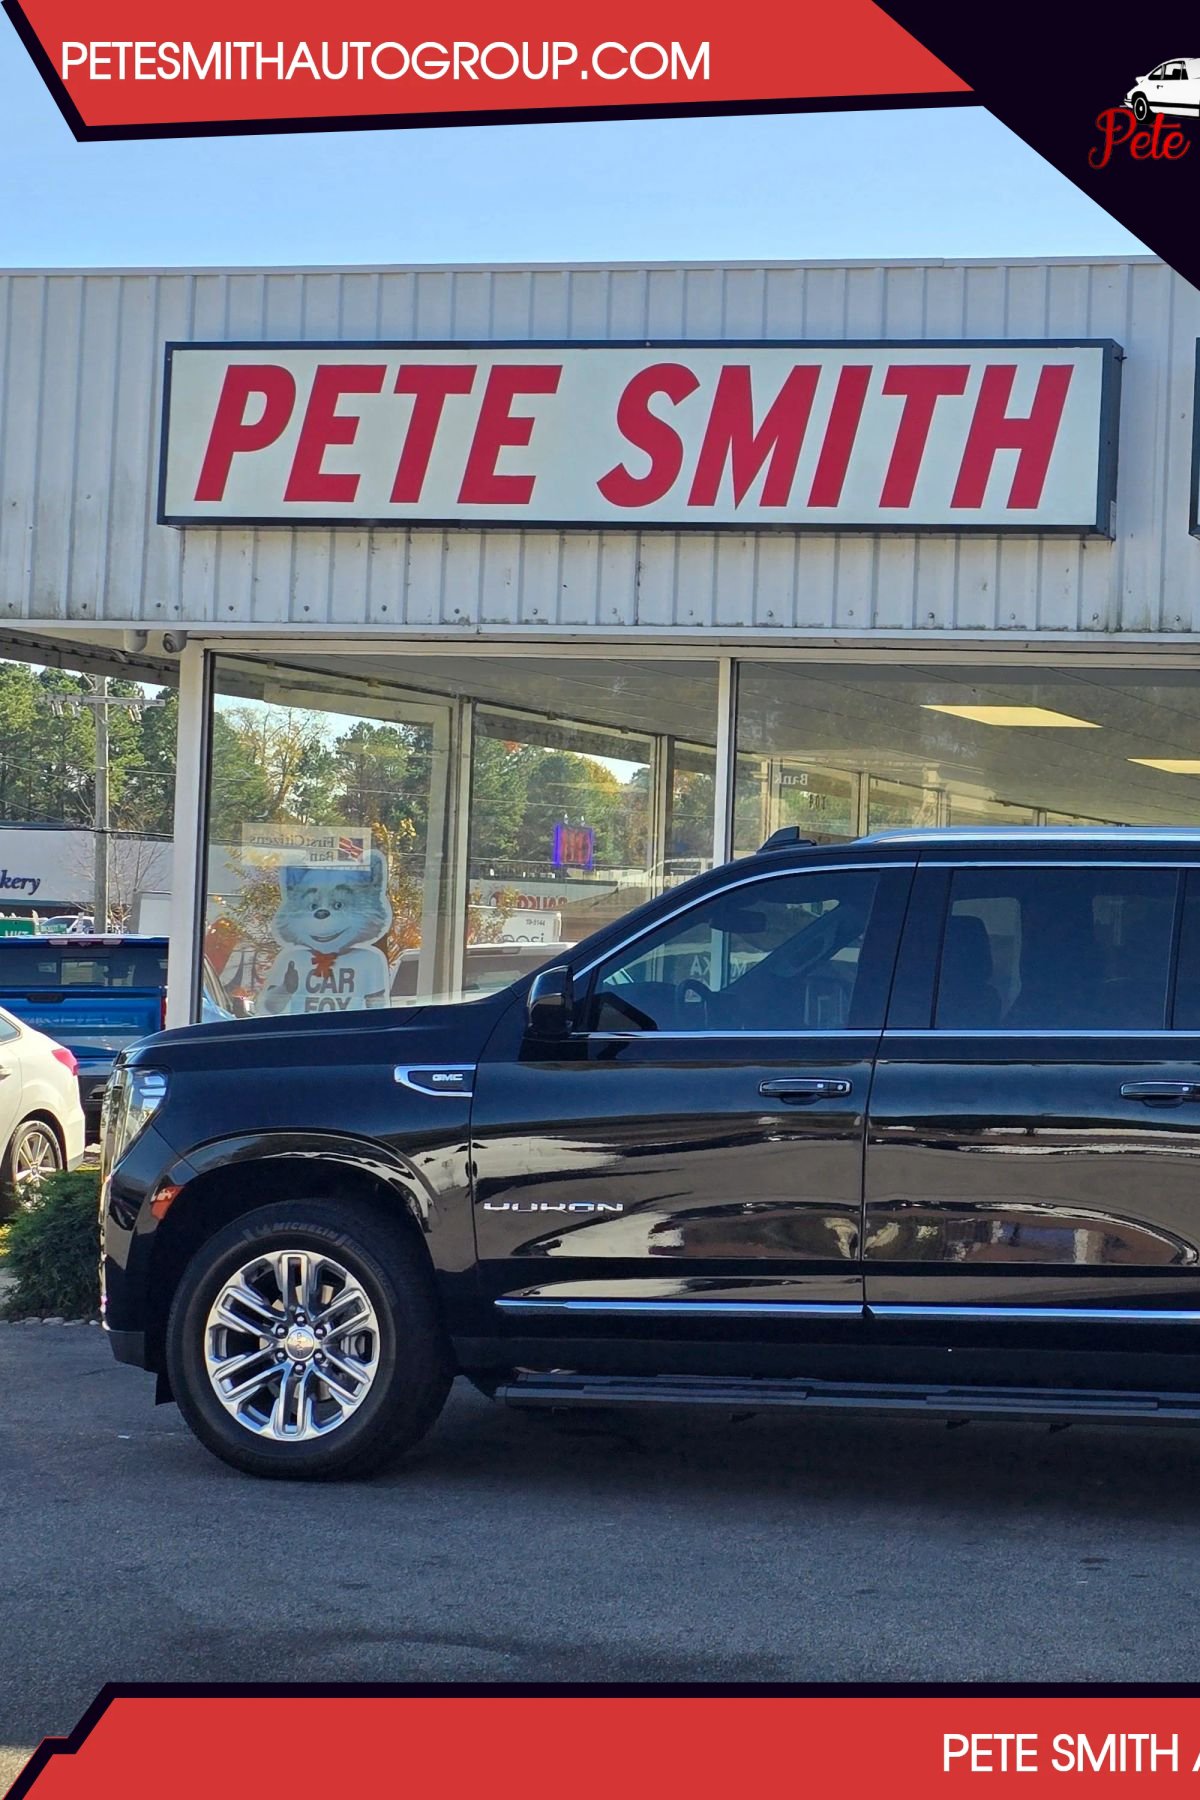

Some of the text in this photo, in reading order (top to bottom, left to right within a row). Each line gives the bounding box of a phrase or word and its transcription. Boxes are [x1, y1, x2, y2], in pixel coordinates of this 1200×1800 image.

[194, 363, 1073, 509] PETE SMITH
[0, 869, 42, 896] kery
[305, 967, 355, 994] CAR
[432, 1073, 464, 1081] GMC
[483, 1202, 624, 1213] YUKON
